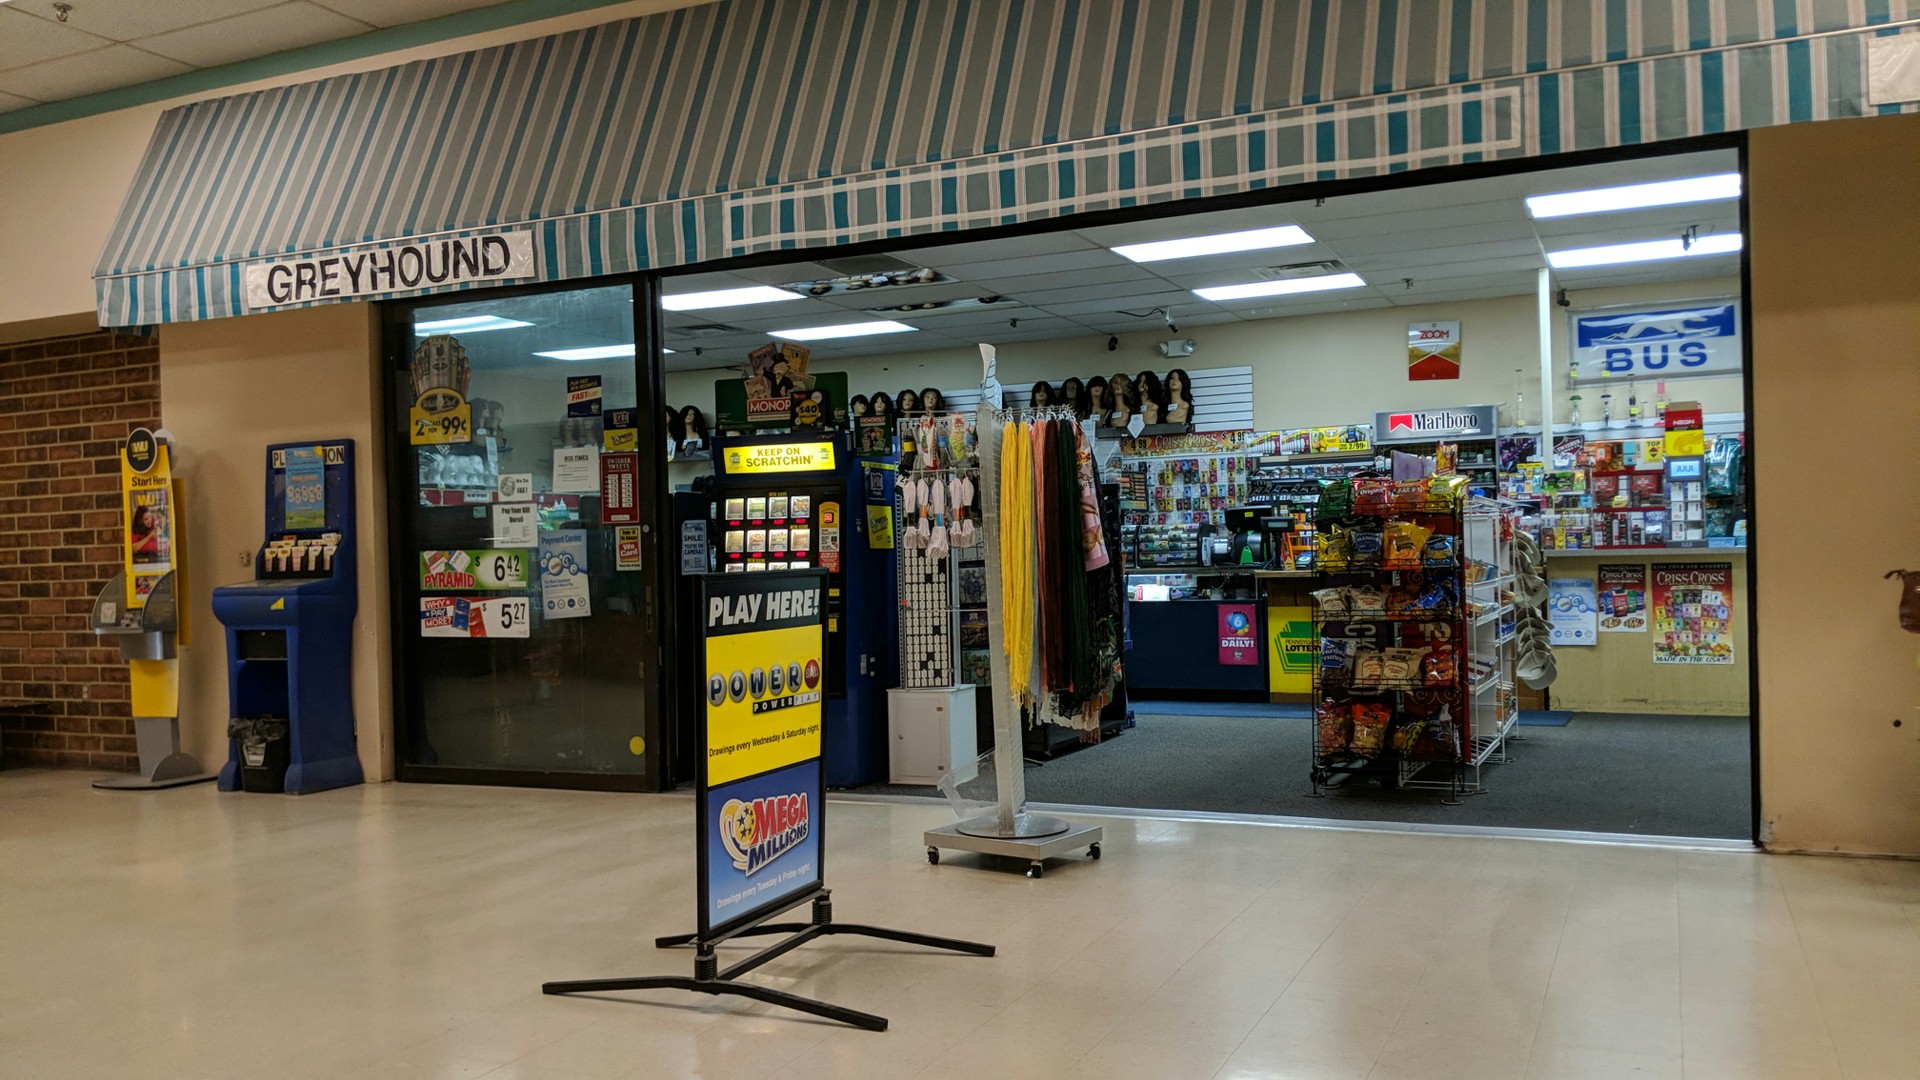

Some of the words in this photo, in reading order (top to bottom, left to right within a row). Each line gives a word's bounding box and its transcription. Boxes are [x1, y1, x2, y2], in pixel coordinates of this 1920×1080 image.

[268, 235, 510, 303] GREYHOUND
[1419, 329, 1450, 340] ZOOM
[1605, 341, 1708, 373] BUS
[571, 391, 588, 401] FAST
[749, 399, 791, 412] MONOP
[799, 405, 817, 414] $40
[1414, 411, 1478, 431] Marlboro
[131, 440, 149, 453] WU
[757, 447, 783, 457] KEEP
[785, 446, 800, 456] ON
[746, 455, 814, 467] SCRATCHIN'
[131, 475, 152, 487] Start
[152, 474, 167, 485] Here
[136, 493, 155, 506] WU
[541, 535, 565, 546] Payment
[565, 534, 582, 543] Center
[620, 548, 639, 557] Card
[622, 543, 635, 551] We
[474, 555, 481, 567] $
[424, 571, 475, 589] PYRAMID
[1551, 580, 1575, 590] Payment
[1575, 580, 1593, 589] Center
[425, 599, 446, 609] WHY
[482, 603, 488, 612] $
[708, 593, 763, 628] PLAY
[765, 588, 820, 621] HERE!
[430, 609, 446, 617] PAY
[425, 617, 452, 627] MORE?
[1234, 617, 1243, 627] 6
[1221, 639, 1254, 648] DAILY!
[1285, 644, 1322, 652] LOTTERY
[708, 743, 736, 758] Drawings
[736, 741, 752, 753] every
[752, 731, 781, 748] Wednesday
[786, 725, 807, 741] Saturday
[752, 794, 808, 846] MEGA
[747, 822, 808, 871] MILLIONS
[716, 890, 742, 909] Drawings
[742, 885, 757, 900] every
[756, 877, 777, 893] Tuesday
[782, 869, 798, 881] Friday
